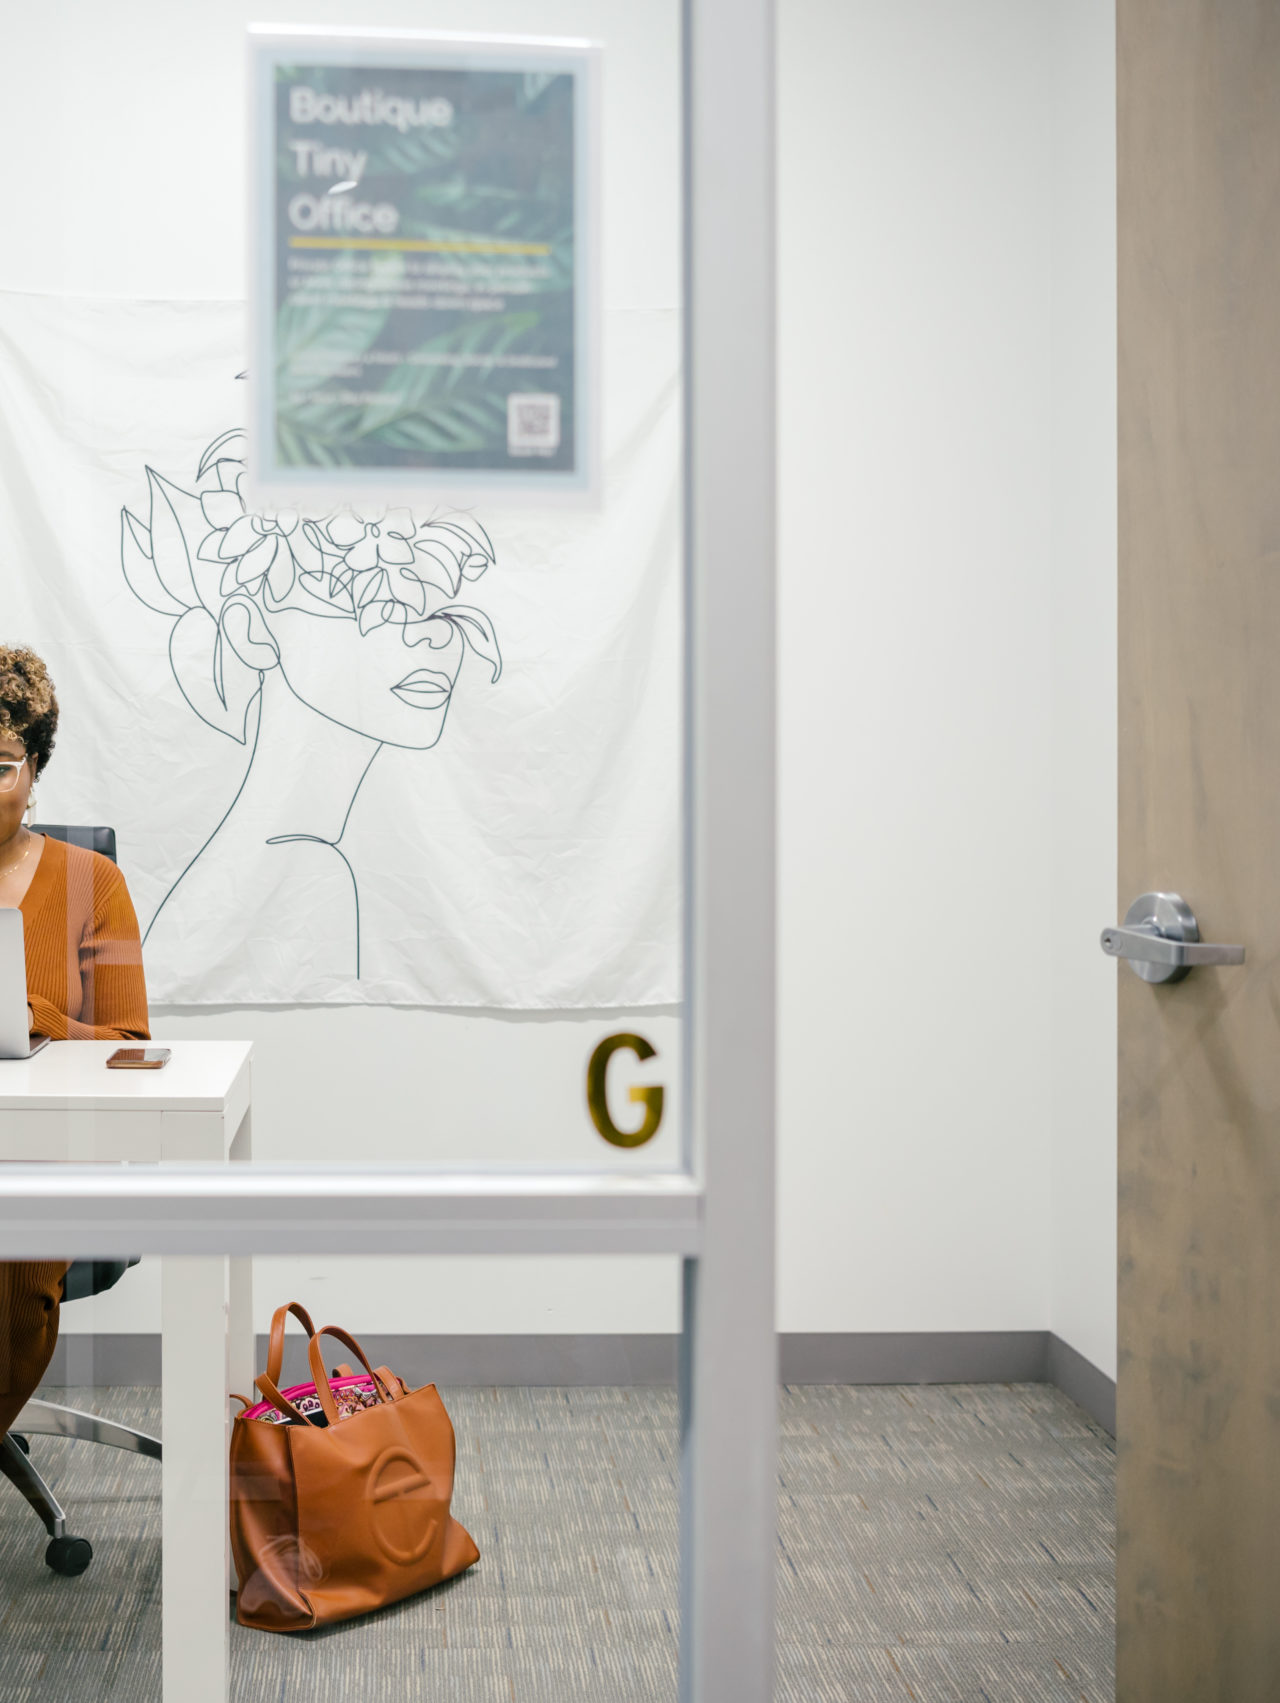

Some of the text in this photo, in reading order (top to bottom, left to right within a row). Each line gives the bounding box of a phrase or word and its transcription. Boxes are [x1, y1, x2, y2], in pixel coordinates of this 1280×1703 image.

[290, 86, 453, 133] Boutique
[290, 140, 367, 184] Tiny
[289, 192, 399, 233] Office
[587, 1033, 664, 1148] G
